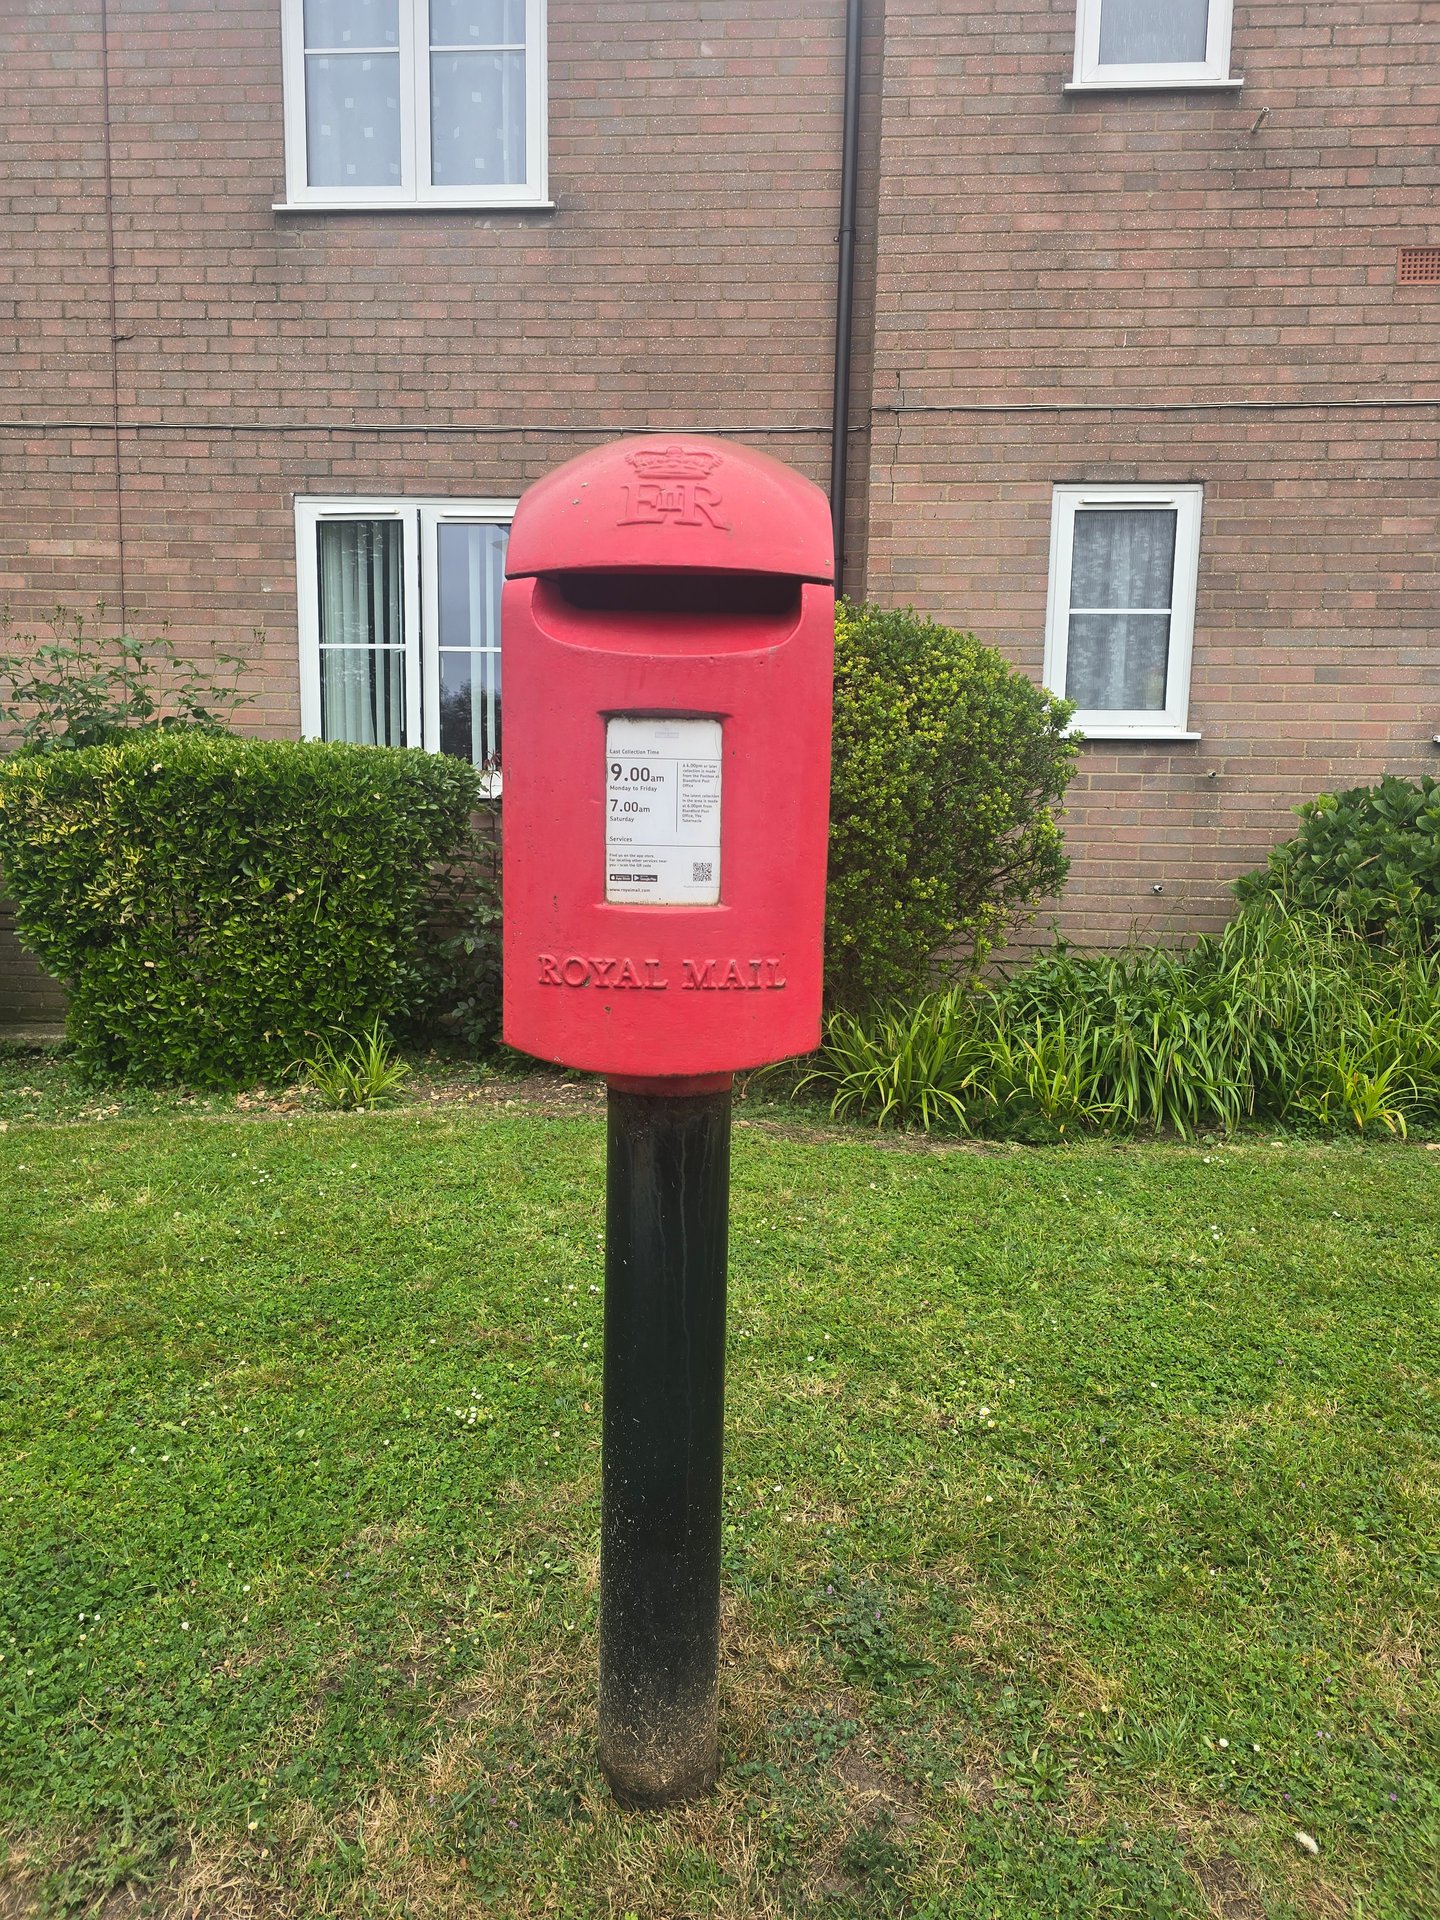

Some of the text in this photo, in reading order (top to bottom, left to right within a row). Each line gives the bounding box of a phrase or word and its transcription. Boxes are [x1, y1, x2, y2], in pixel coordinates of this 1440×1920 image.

[610, 763, 664, 782] 9.00am
[610, 799, 650, 812] 7.00am
[538, 953, 787, 990] ROYAL MAIL
